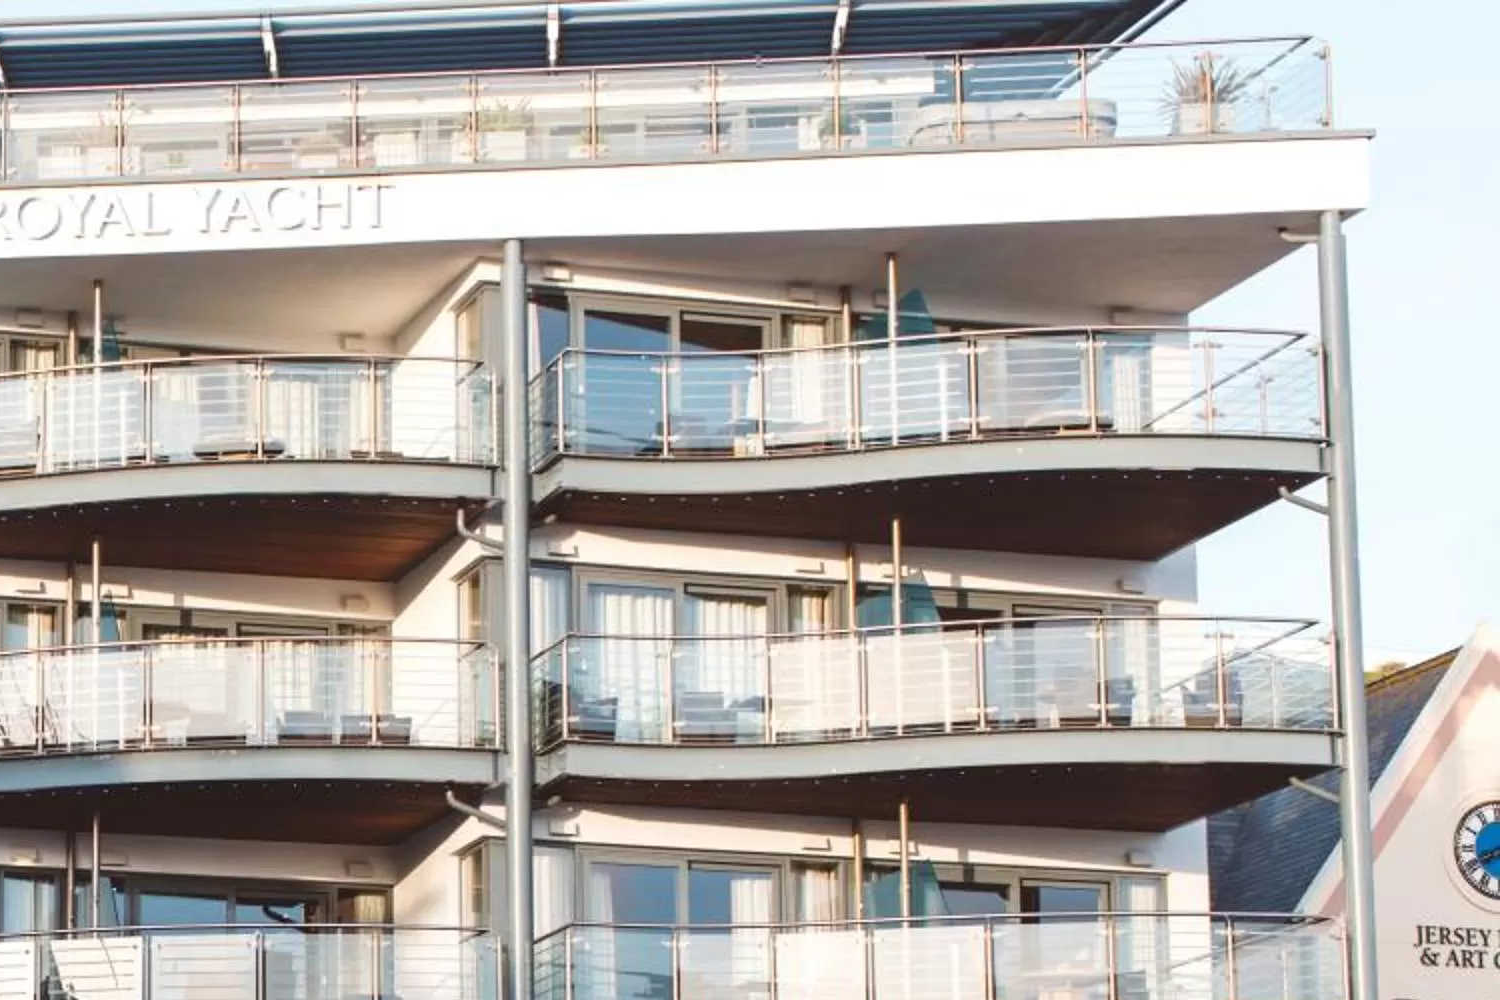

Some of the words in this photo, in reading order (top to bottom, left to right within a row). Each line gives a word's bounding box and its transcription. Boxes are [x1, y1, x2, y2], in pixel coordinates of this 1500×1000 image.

[195, 183, 397, 235] YACHT
[1413, 924, 1492, 949] JERSEY
[1419, 948, 1441, 968] &
[1445, 949, 1488, 969] ART
